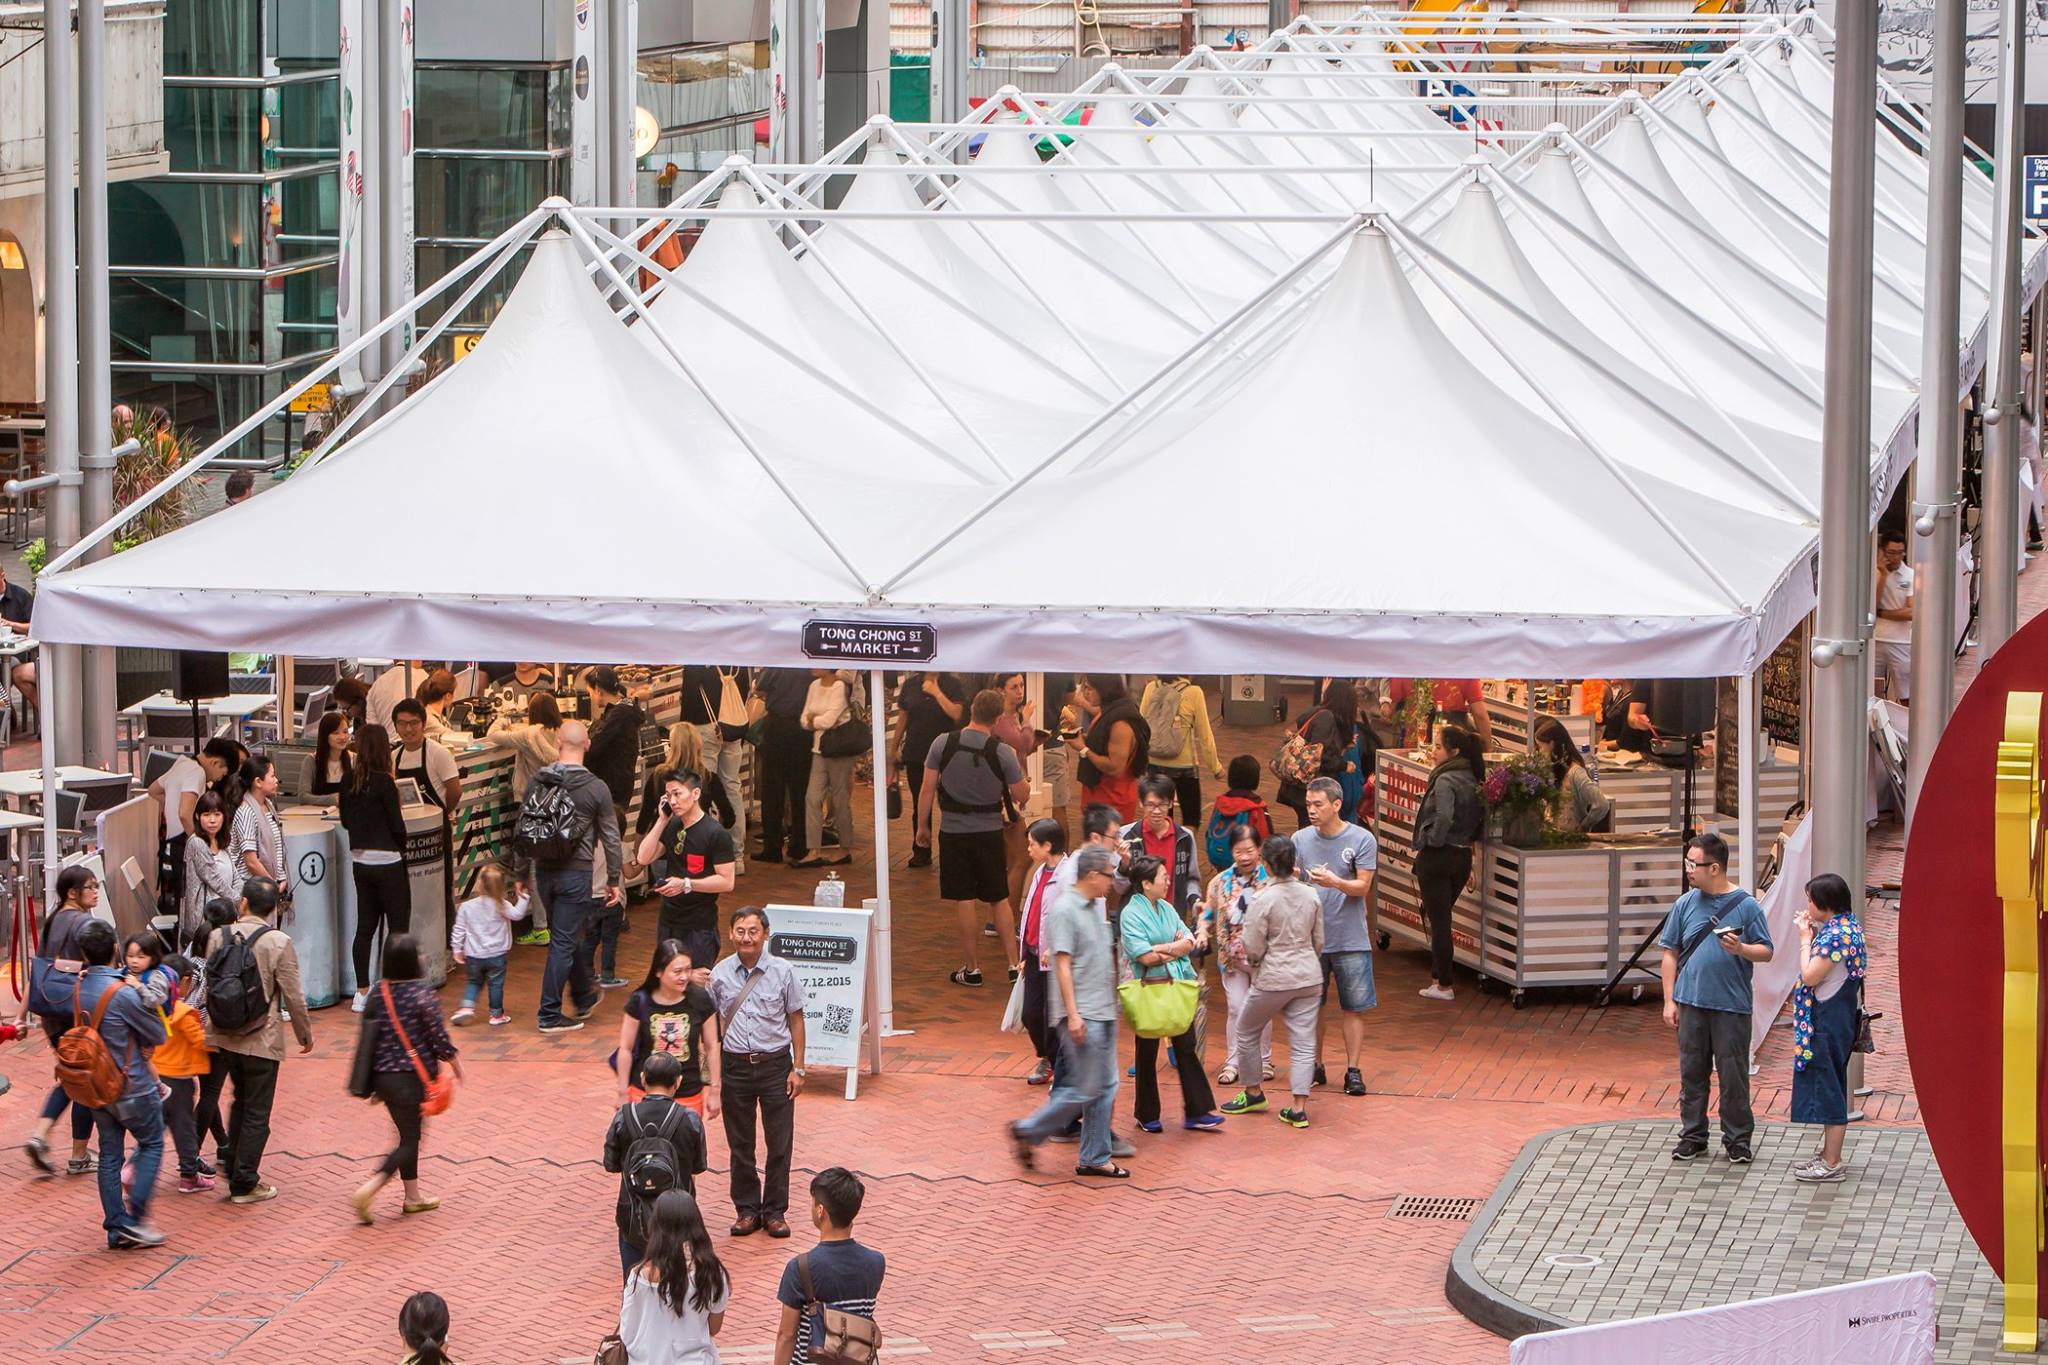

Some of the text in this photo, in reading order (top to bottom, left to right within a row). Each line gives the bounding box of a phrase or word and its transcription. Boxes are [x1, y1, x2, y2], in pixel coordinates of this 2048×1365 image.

[819, 628, 922, 641] TONG CHONG ST
[840, 642, 900, 654] MARKET
[406, 846, 438, 860] MARKET
[780, 938, 804, 947] TONG
[806, 940, 837, 949] CHONG
[793, 949, 833, 957] MARKET
[800, 977, 851, 987] 7.12.2015
